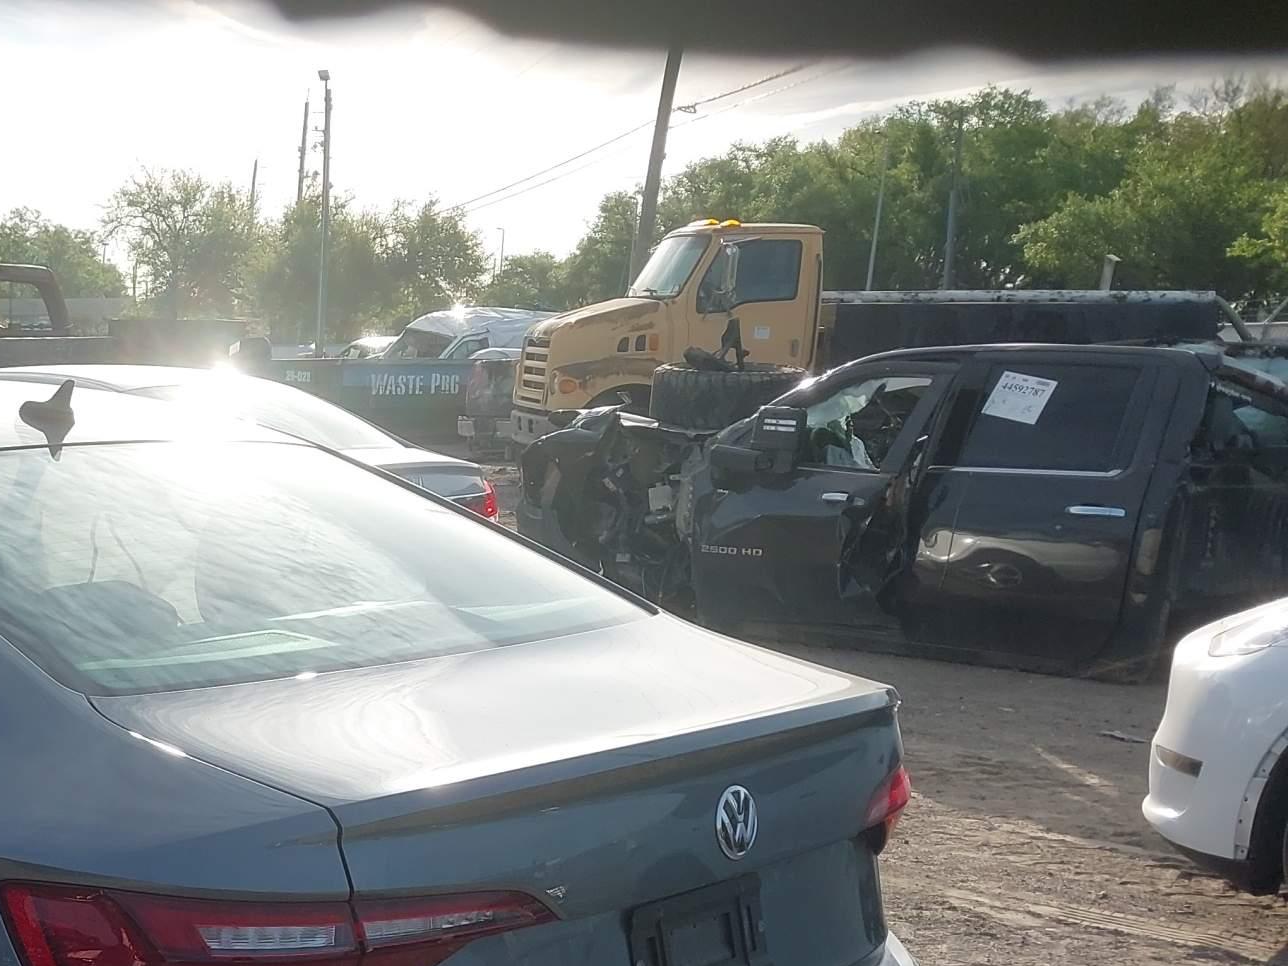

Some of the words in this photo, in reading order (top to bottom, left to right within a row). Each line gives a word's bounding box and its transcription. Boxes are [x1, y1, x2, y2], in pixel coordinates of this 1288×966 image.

[371, 373, 424, 395] WASTE
[701, 544, 737, 555] 2500
[741, 547, 763, 556] HD
